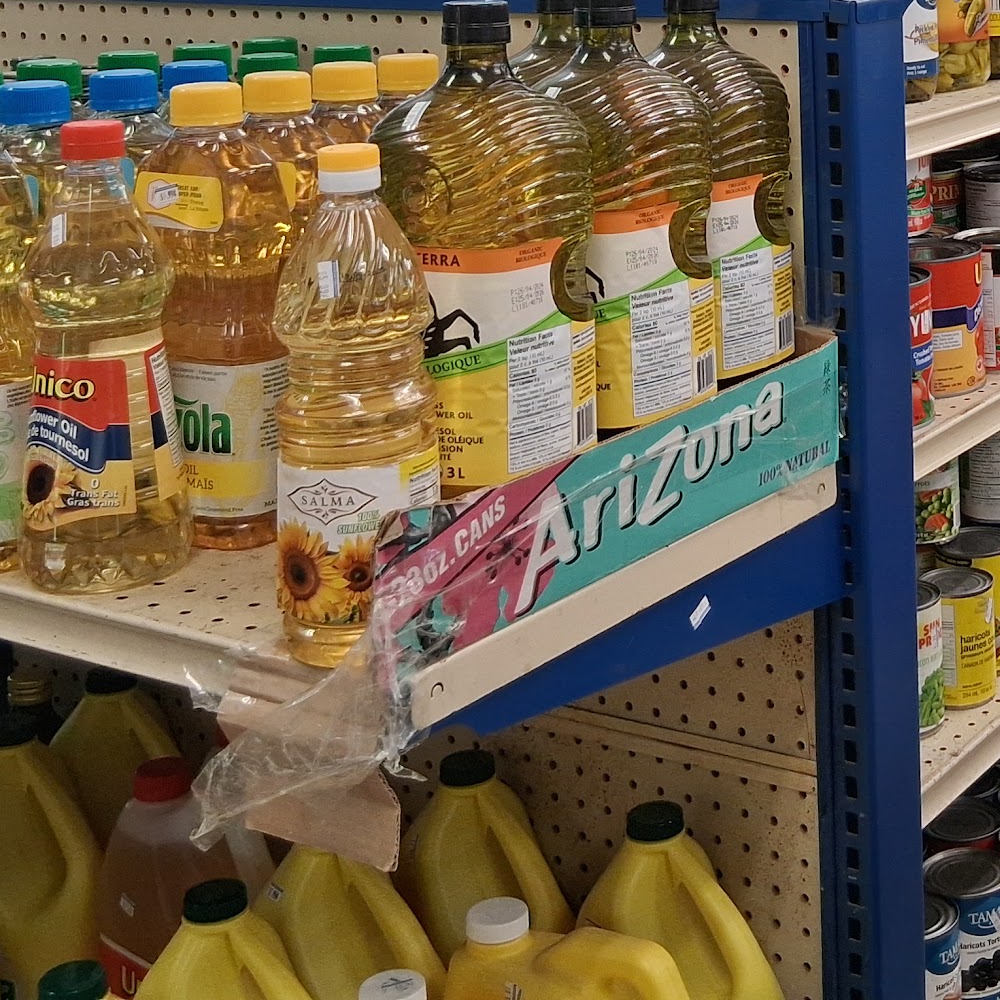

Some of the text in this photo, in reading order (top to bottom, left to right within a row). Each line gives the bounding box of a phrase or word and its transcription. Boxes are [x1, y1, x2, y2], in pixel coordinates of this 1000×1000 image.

[435, 411, 474, 420] WER OIL
[61, 419, 78, 440] Oil
[40, 425, 90, 462] tournesol
[447, 435, 484, 445] OLÉIQUE
[786, 441, 831, 475] NATURAL
[447, 467, 466, 479] 3 L
[90, 478, 99, 489] 0
[70, 488, 119, 499] Trans Fat
[301, 494, 356, 506] SALMA
[514, 381, 784, 616] AriZona
[67, 497, 121, 507] Gras trans
[337, 520, 381, 535] SUNFLOWE
[455, 494, 507, 559] CANS
[960, 629, 991, 644] haricots
[960, 640, 988, 655] jaunes
